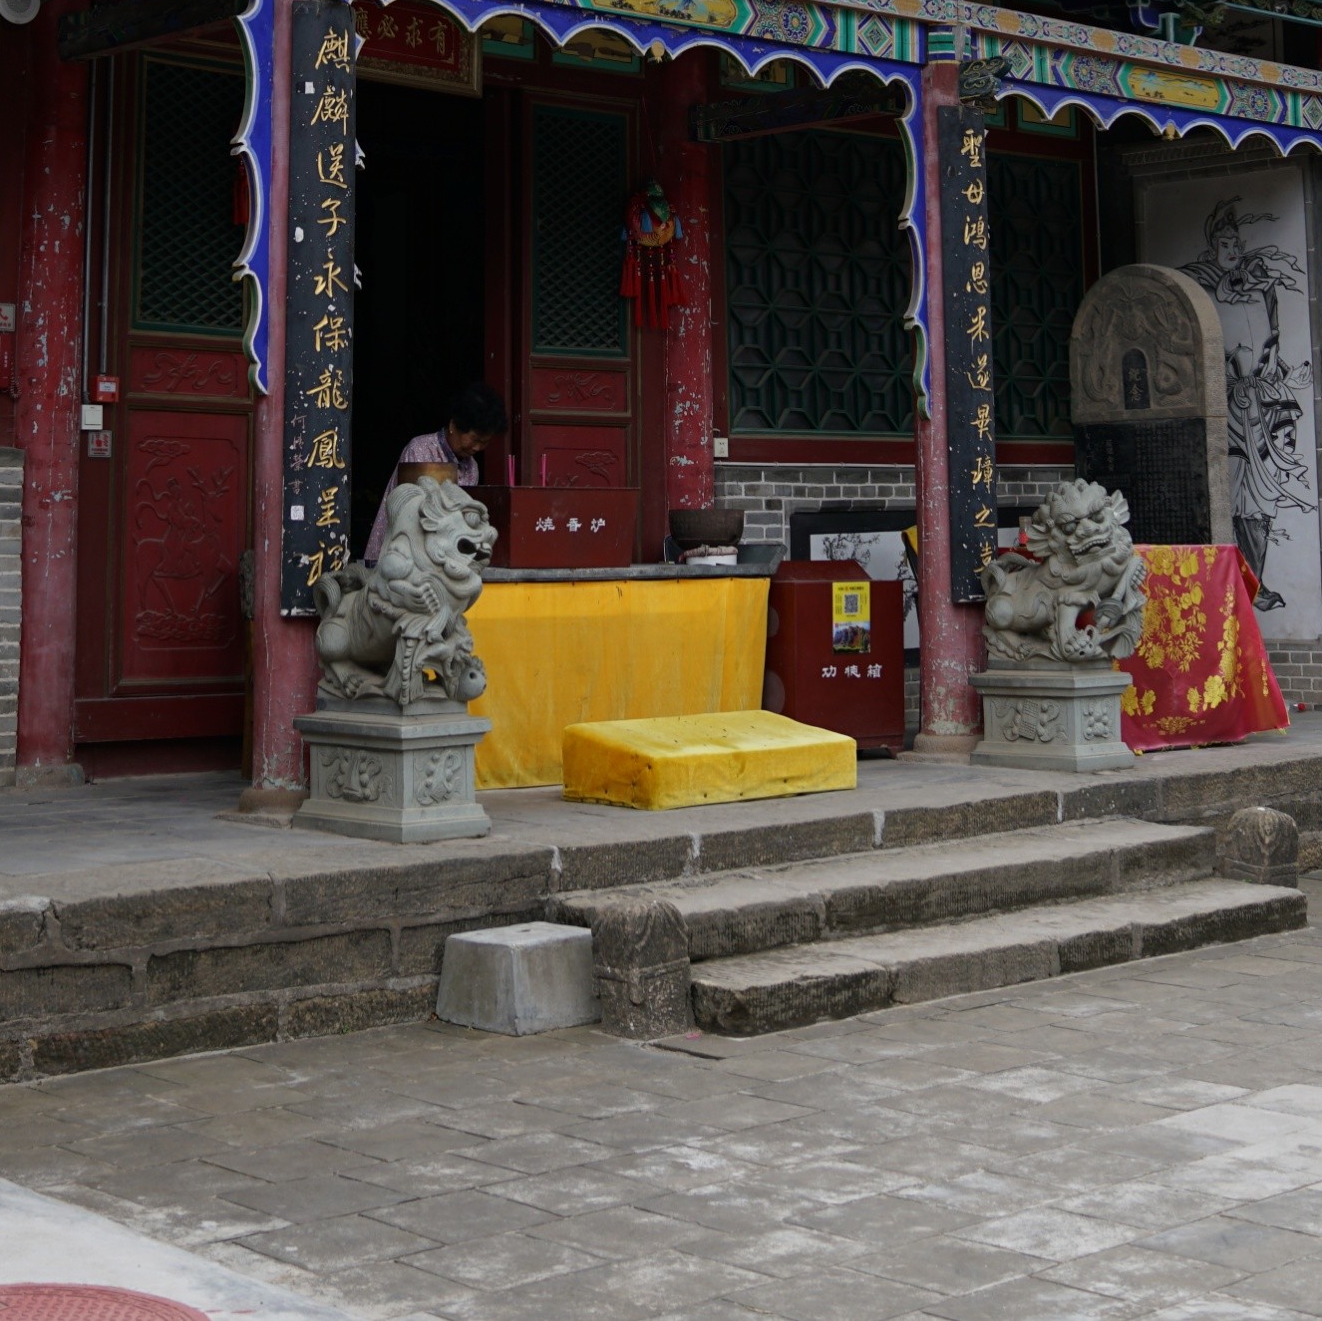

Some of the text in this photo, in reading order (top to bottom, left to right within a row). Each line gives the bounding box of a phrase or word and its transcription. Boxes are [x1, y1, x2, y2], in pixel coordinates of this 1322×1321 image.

[535, 516, 606, 533] 烧香炉
[821, 663, 883, 678] 功德箱
